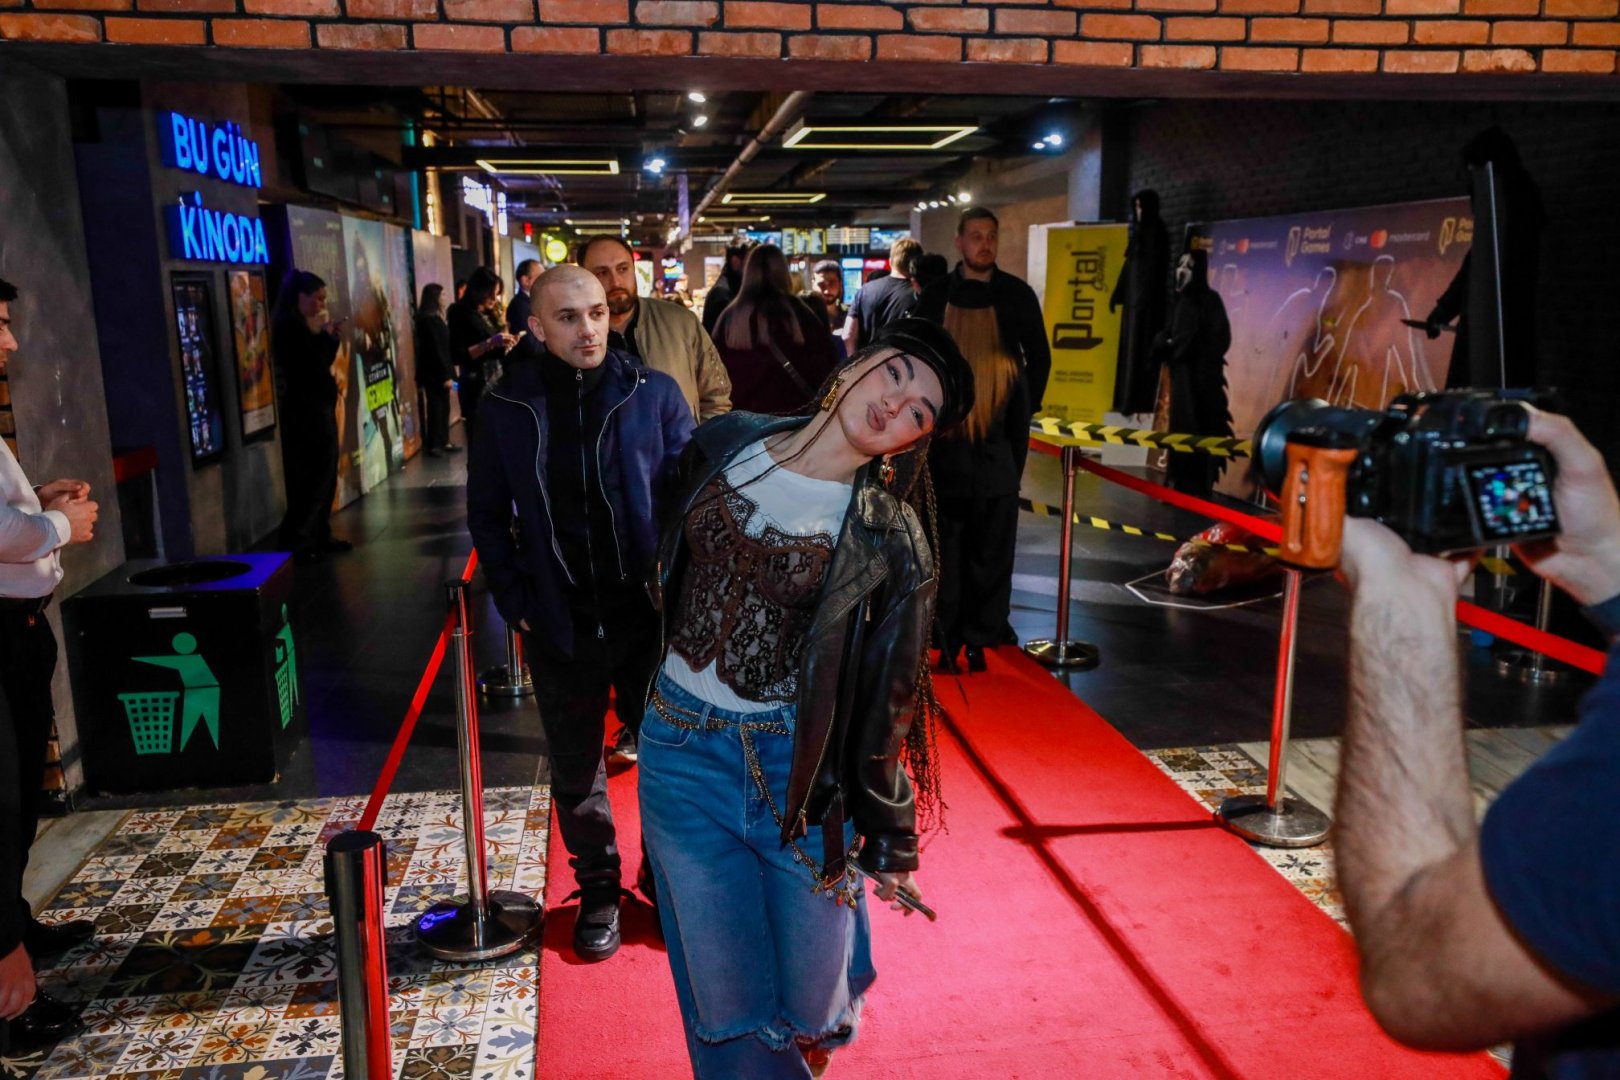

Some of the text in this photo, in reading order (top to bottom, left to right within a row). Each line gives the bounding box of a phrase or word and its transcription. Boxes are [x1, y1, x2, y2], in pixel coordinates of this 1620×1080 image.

[171, 111, 262, 189] BU GÜN
[179, 190, 270, 264] KİNODA
[1303, 225, 1332, 240] Portal
